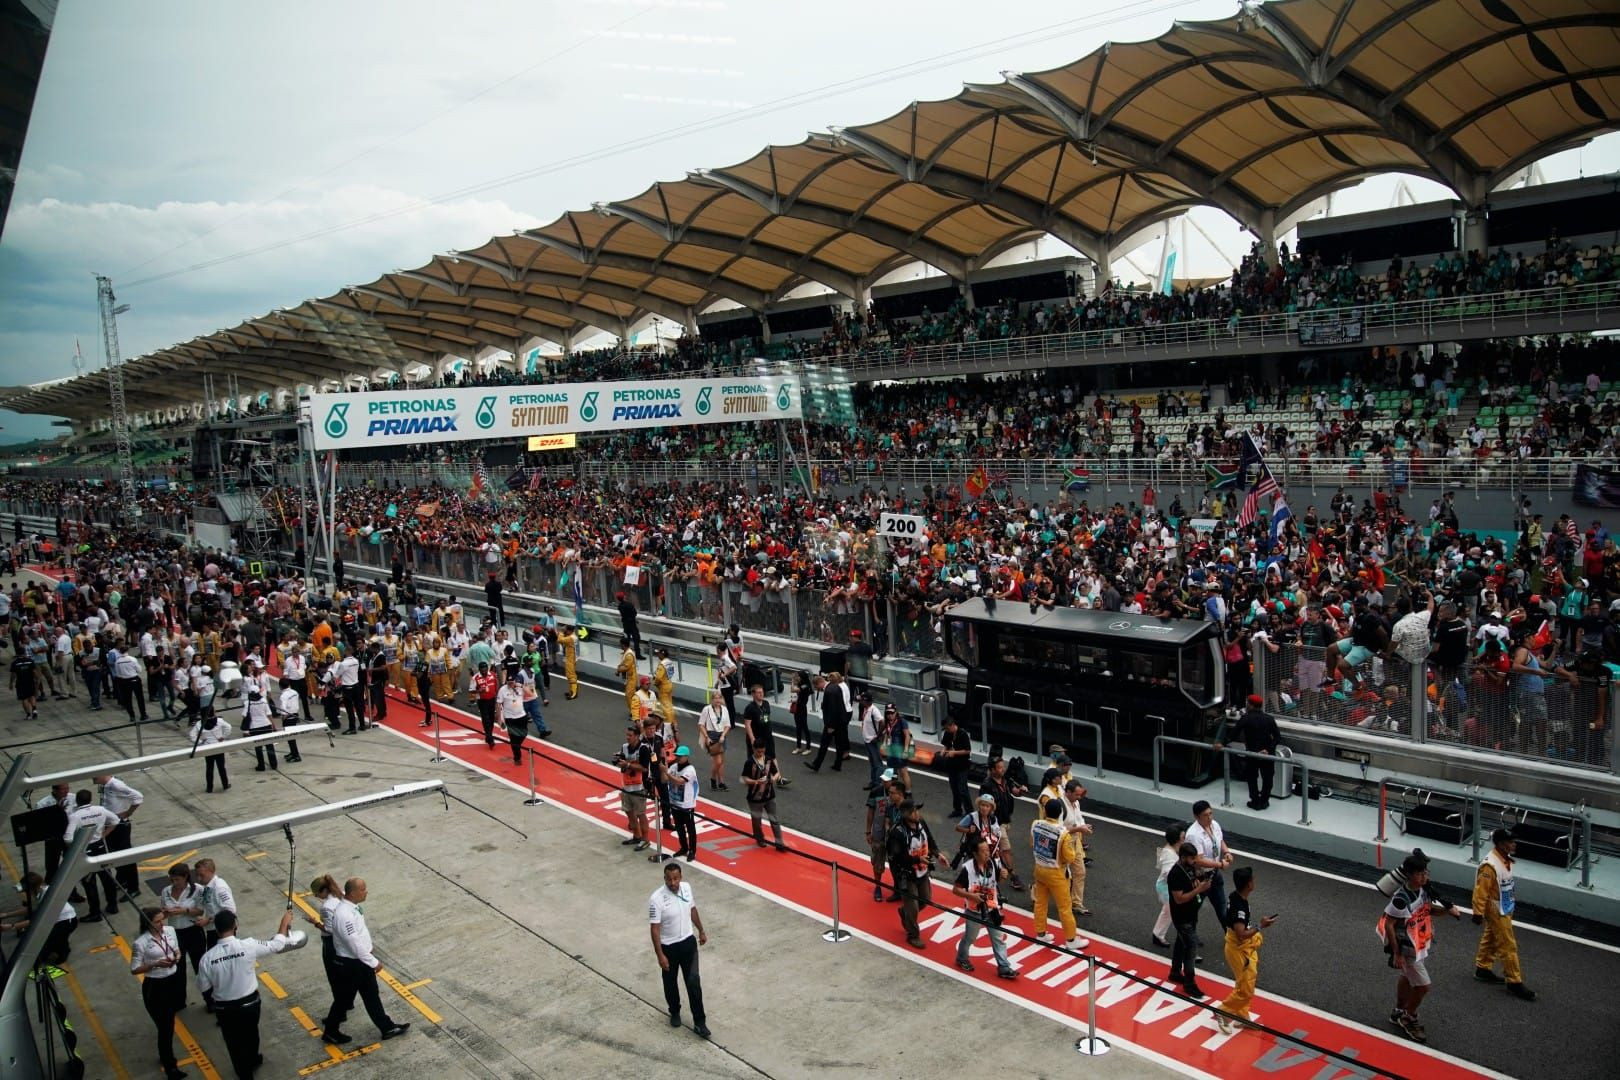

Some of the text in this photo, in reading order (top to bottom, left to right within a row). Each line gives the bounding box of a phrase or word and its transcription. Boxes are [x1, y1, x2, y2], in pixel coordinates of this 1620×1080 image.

[613, 388, 681, 402] PETRONAS
[721, 384, 767, 395] PETRONAS
[368, 398, 456, 415] PETRONAS
[509, 393, 568, 405] PETRONAS
[723, 395, 768, 415] SYNTIUM
[511, 405, 568, 427] SYNTIUM
[612, 403, 682, 421] PRIMAX
[367, 414, 460, 437] PRIMAX
[539, 438, 565, 447] DHL
[886, 518, 916, 534] 200
[210, 951, 245, 966] PETRONAS
[919, 906, 1263, 1051] HAMILTON
